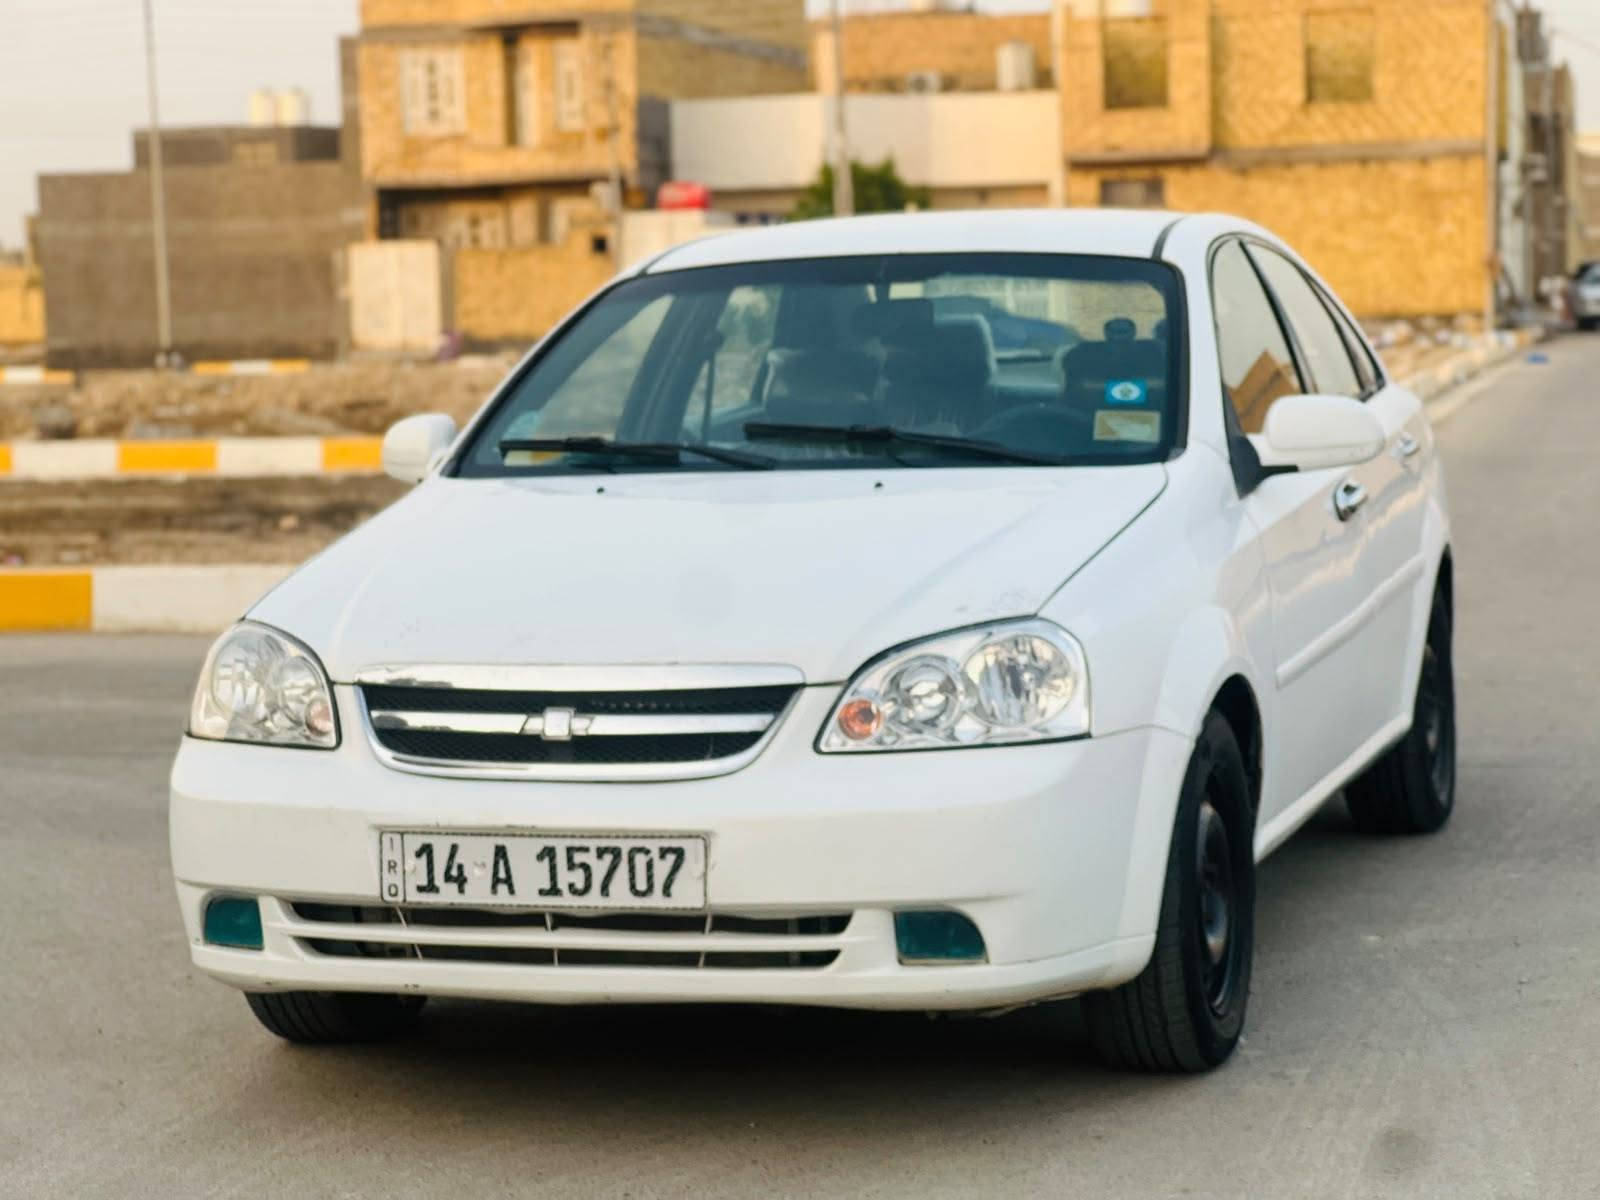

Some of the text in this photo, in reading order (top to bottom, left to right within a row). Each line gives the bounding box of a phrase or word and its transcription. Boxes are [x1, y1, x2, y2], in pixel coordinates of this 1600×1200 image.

[414, 842, 685, 898] 14 A 15707
